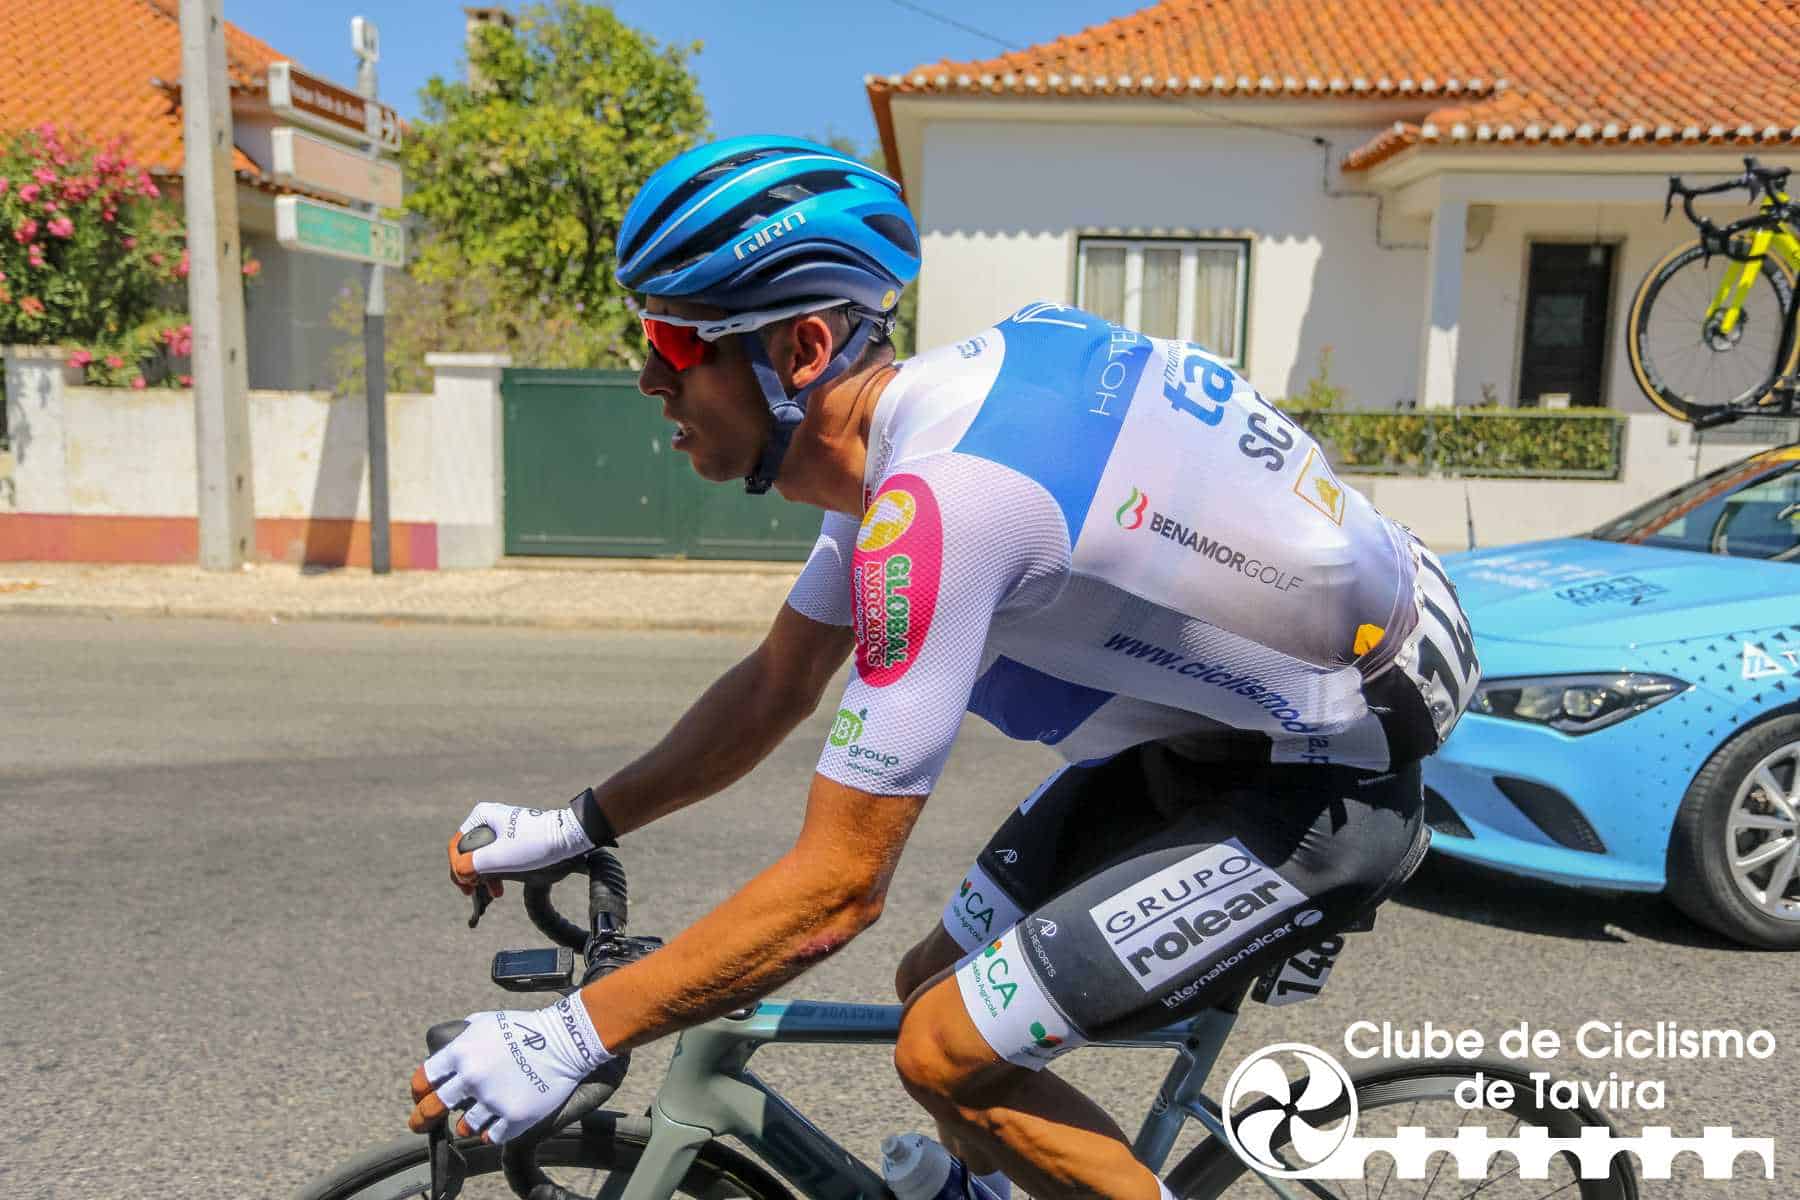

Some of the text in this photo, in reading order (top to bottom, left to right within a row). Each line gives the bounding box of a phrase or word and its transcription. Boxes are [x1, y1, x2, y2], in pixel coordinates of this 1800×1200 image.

[865, 561, 882, 668] AVOCADOS
[884, 554, 912, 669] GLOBAL
[848, 742, 899, 767] group
[1106, 855, 1252, 934] GRUPO
[1127, 879, 1282, 977] rolear
[986, 957, 1019, 1010] CA
[508, 1041, 550, 1094] RESORTS
[563, 1015, 590, 1066] PACTO
